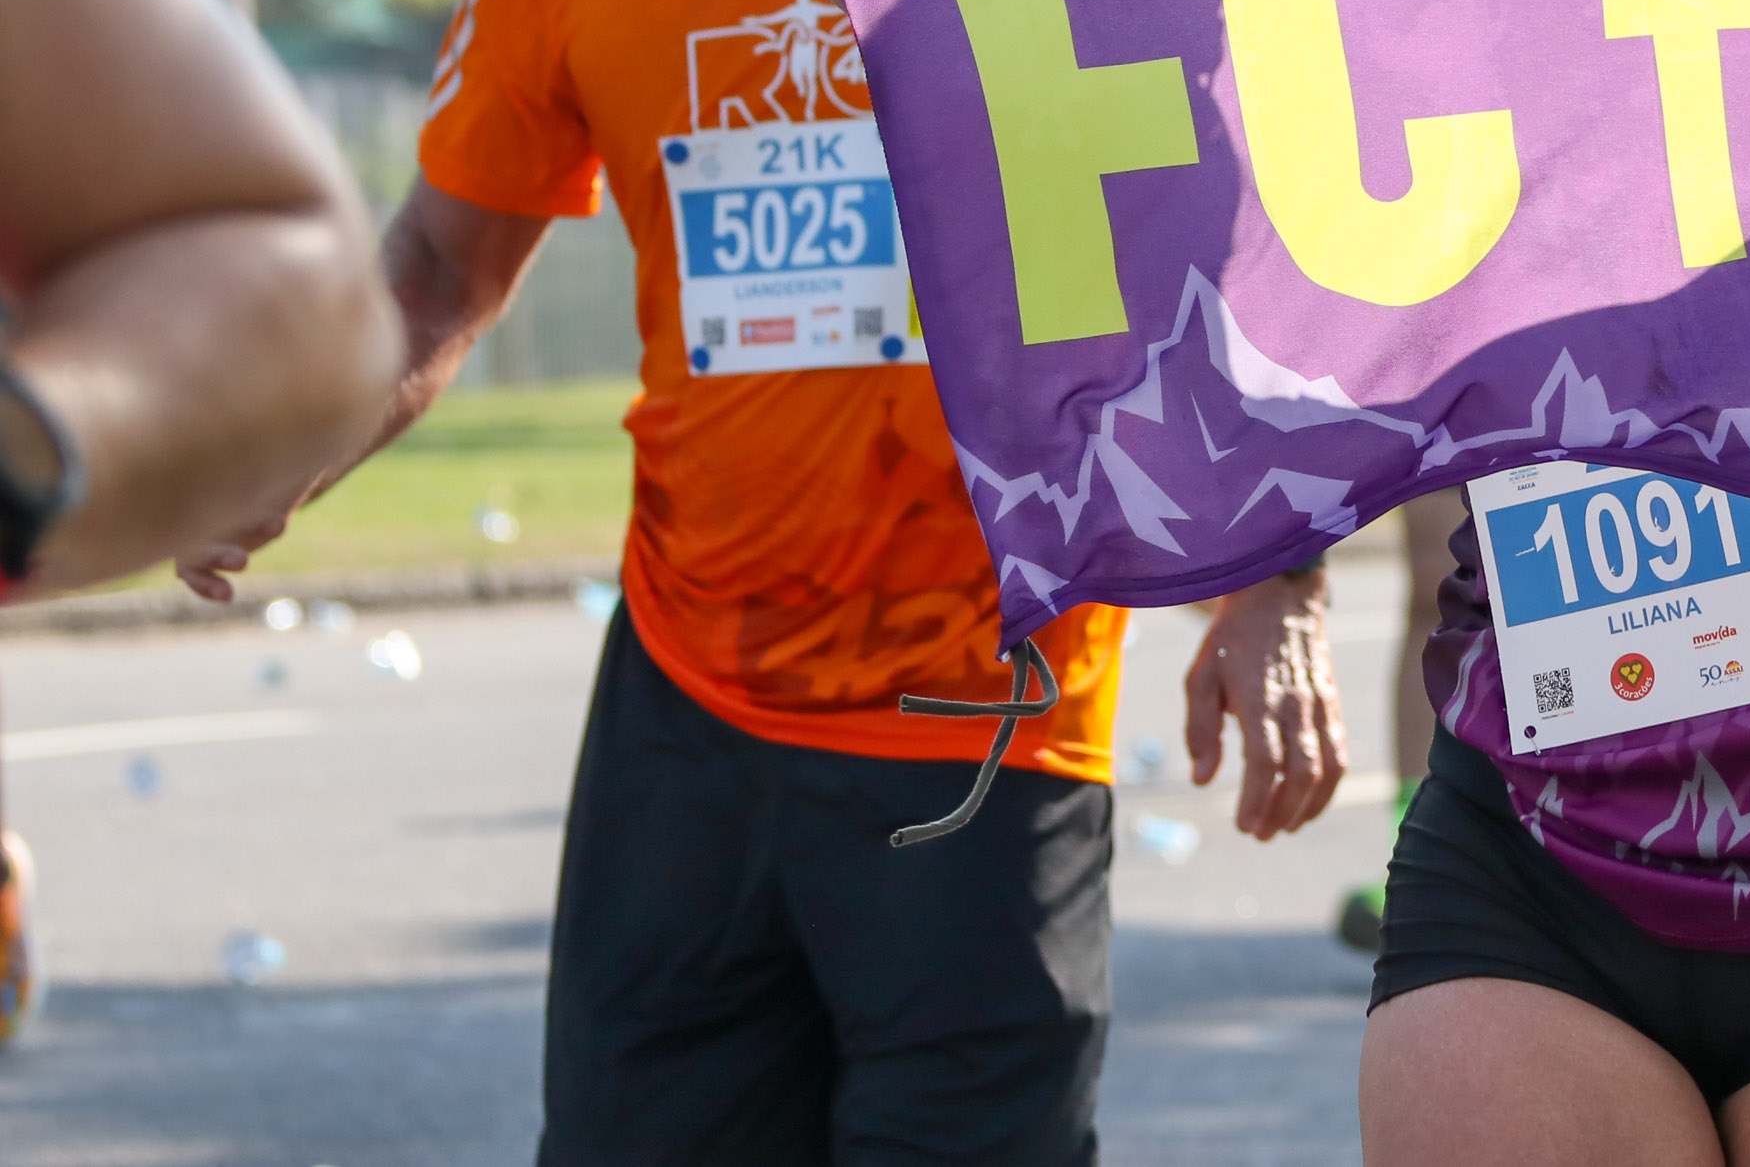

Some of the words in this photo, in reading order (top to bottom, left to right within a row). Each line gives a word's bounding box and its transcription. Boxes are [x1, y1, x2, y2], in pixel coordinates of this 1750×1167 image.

[757, 133, 845, 174] 21K
[712, 184, 868, 272] 5025
[733, 277, 843, 299] LIANDERSON
[1532, 479, 1742, 606] 1091
[1607, 596, 1703, 635] LILIANA
[1698, 664, 1723, 689] 50
